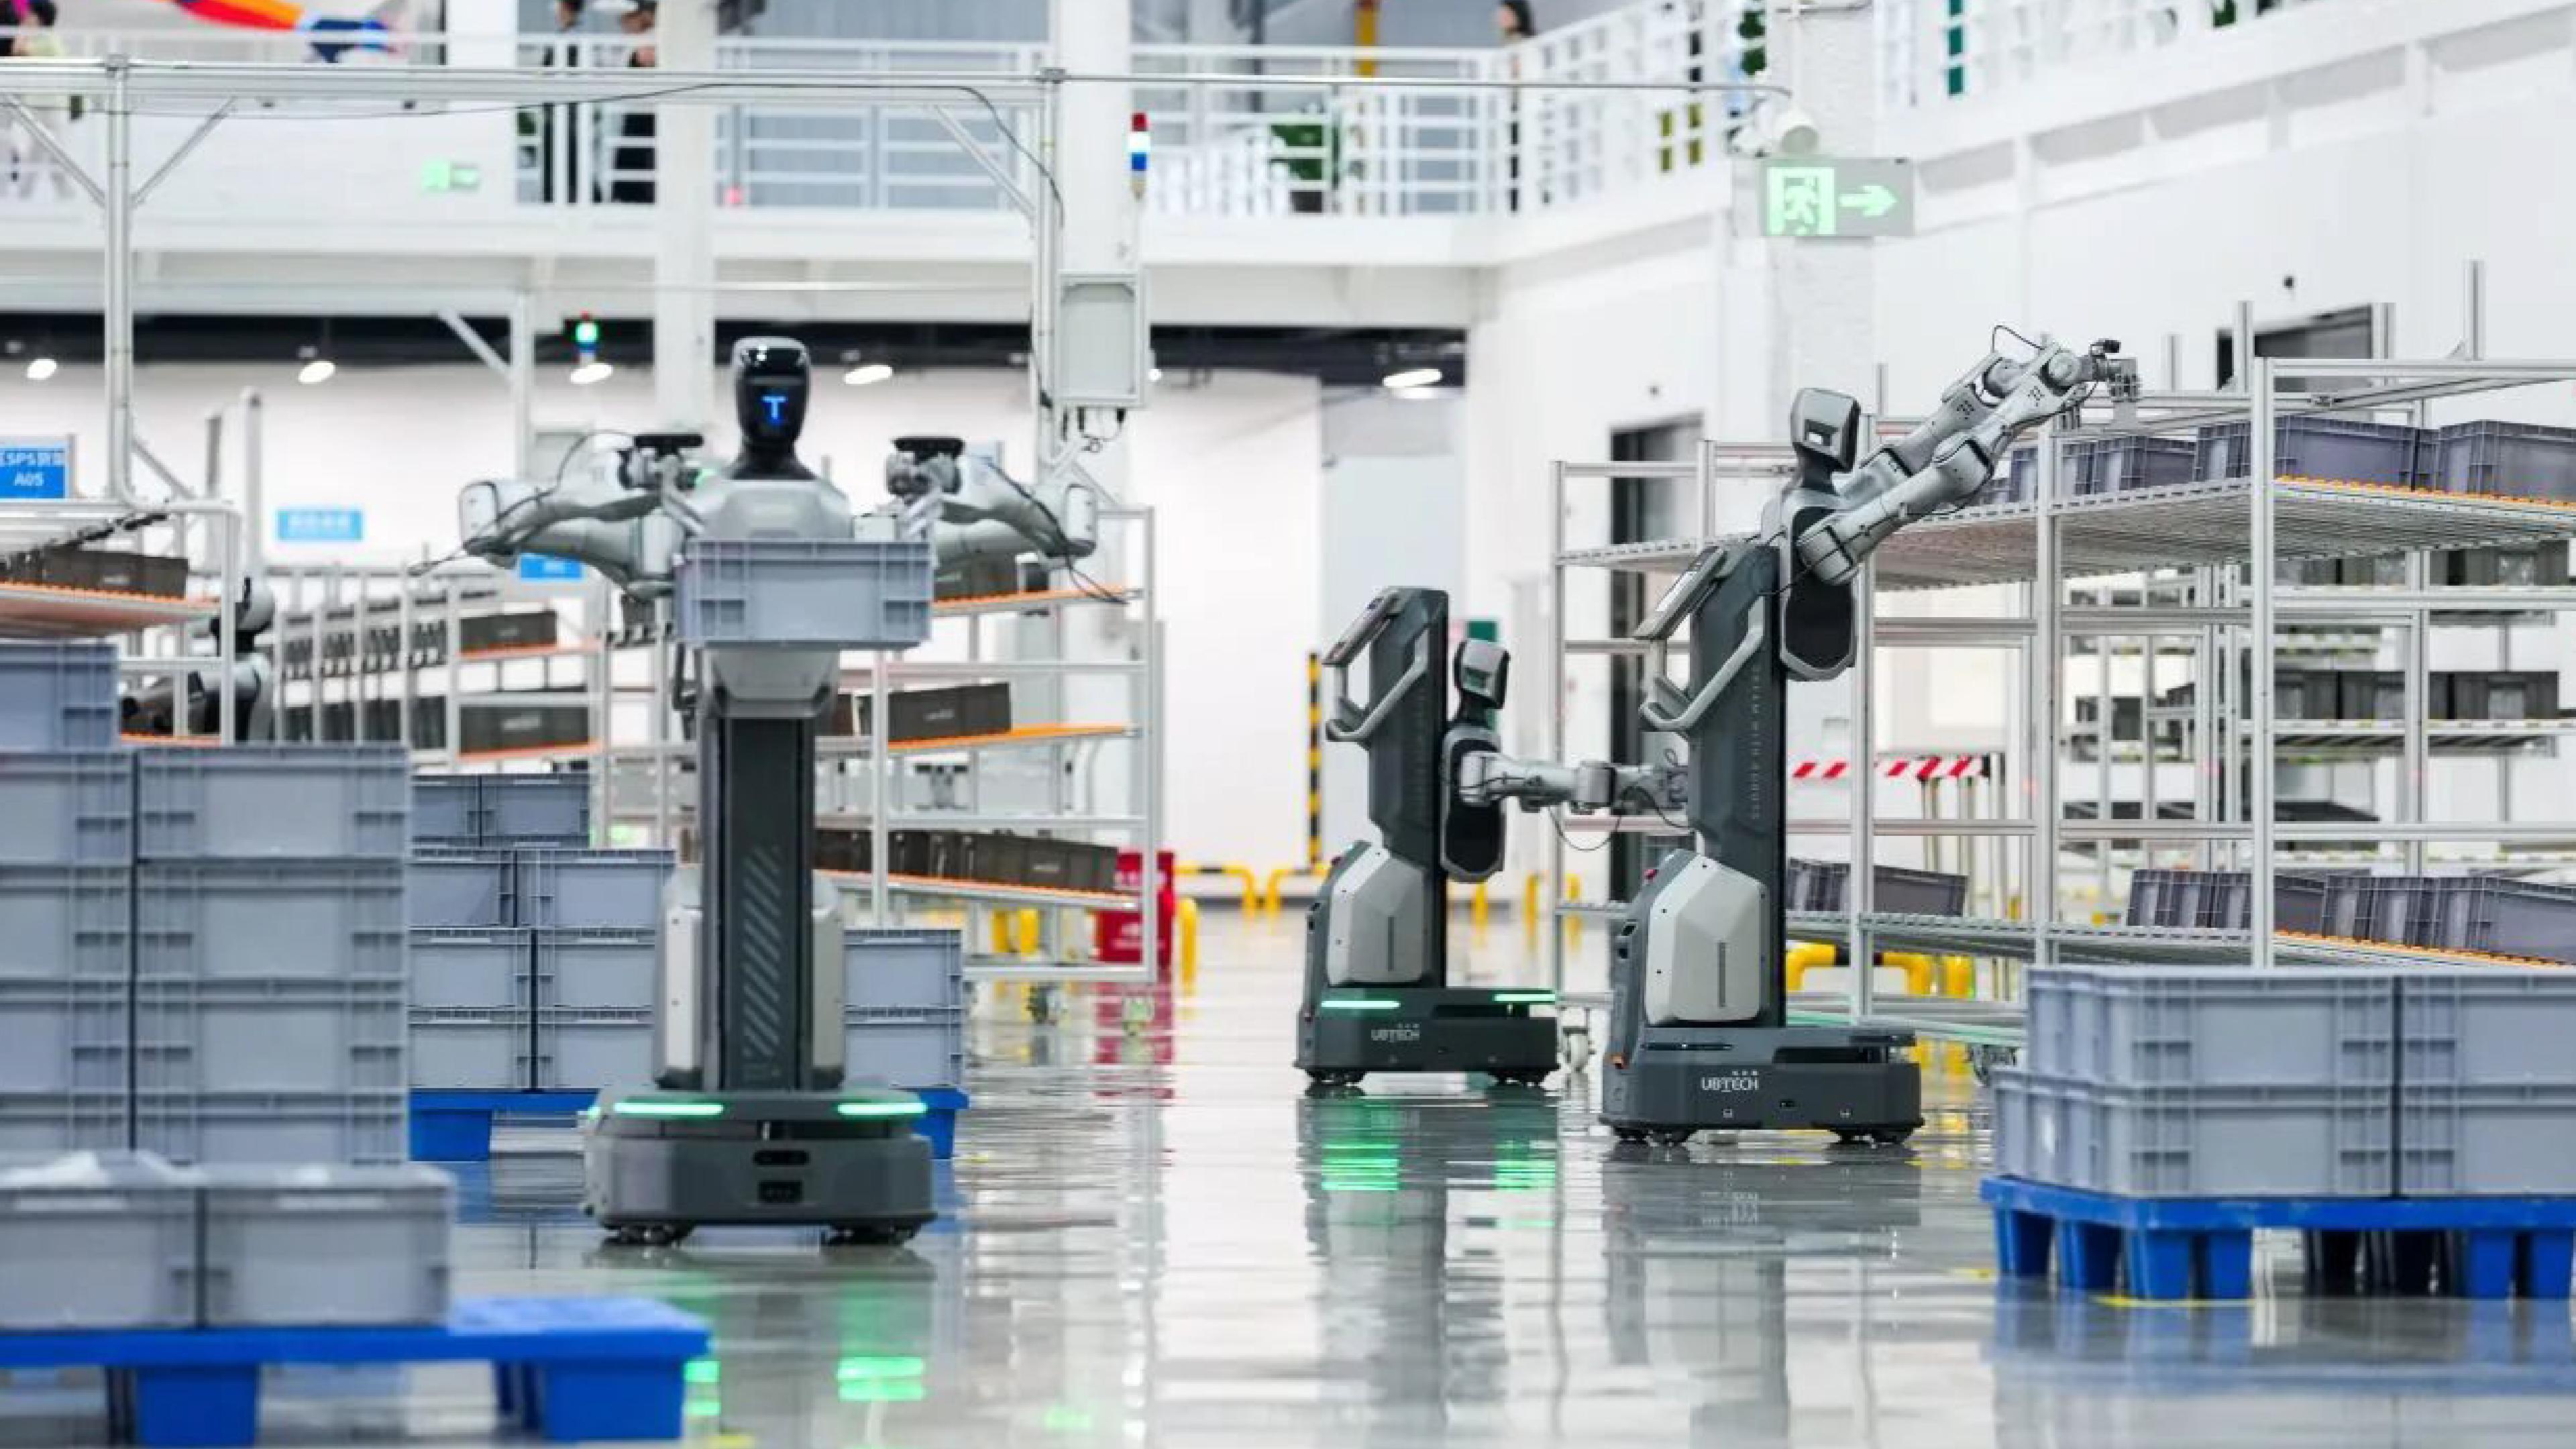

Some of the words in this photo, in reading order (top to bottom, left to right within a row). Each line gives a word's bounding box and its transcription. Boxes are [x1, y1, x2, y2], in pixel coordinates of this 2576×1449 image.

[761, 396, 788, 420] T
[13, 471, 44, 486] A05
[1371, 1029, 1420, 1042] UBTECH
[1701, 1077, 1760, 1093] UBTECH
